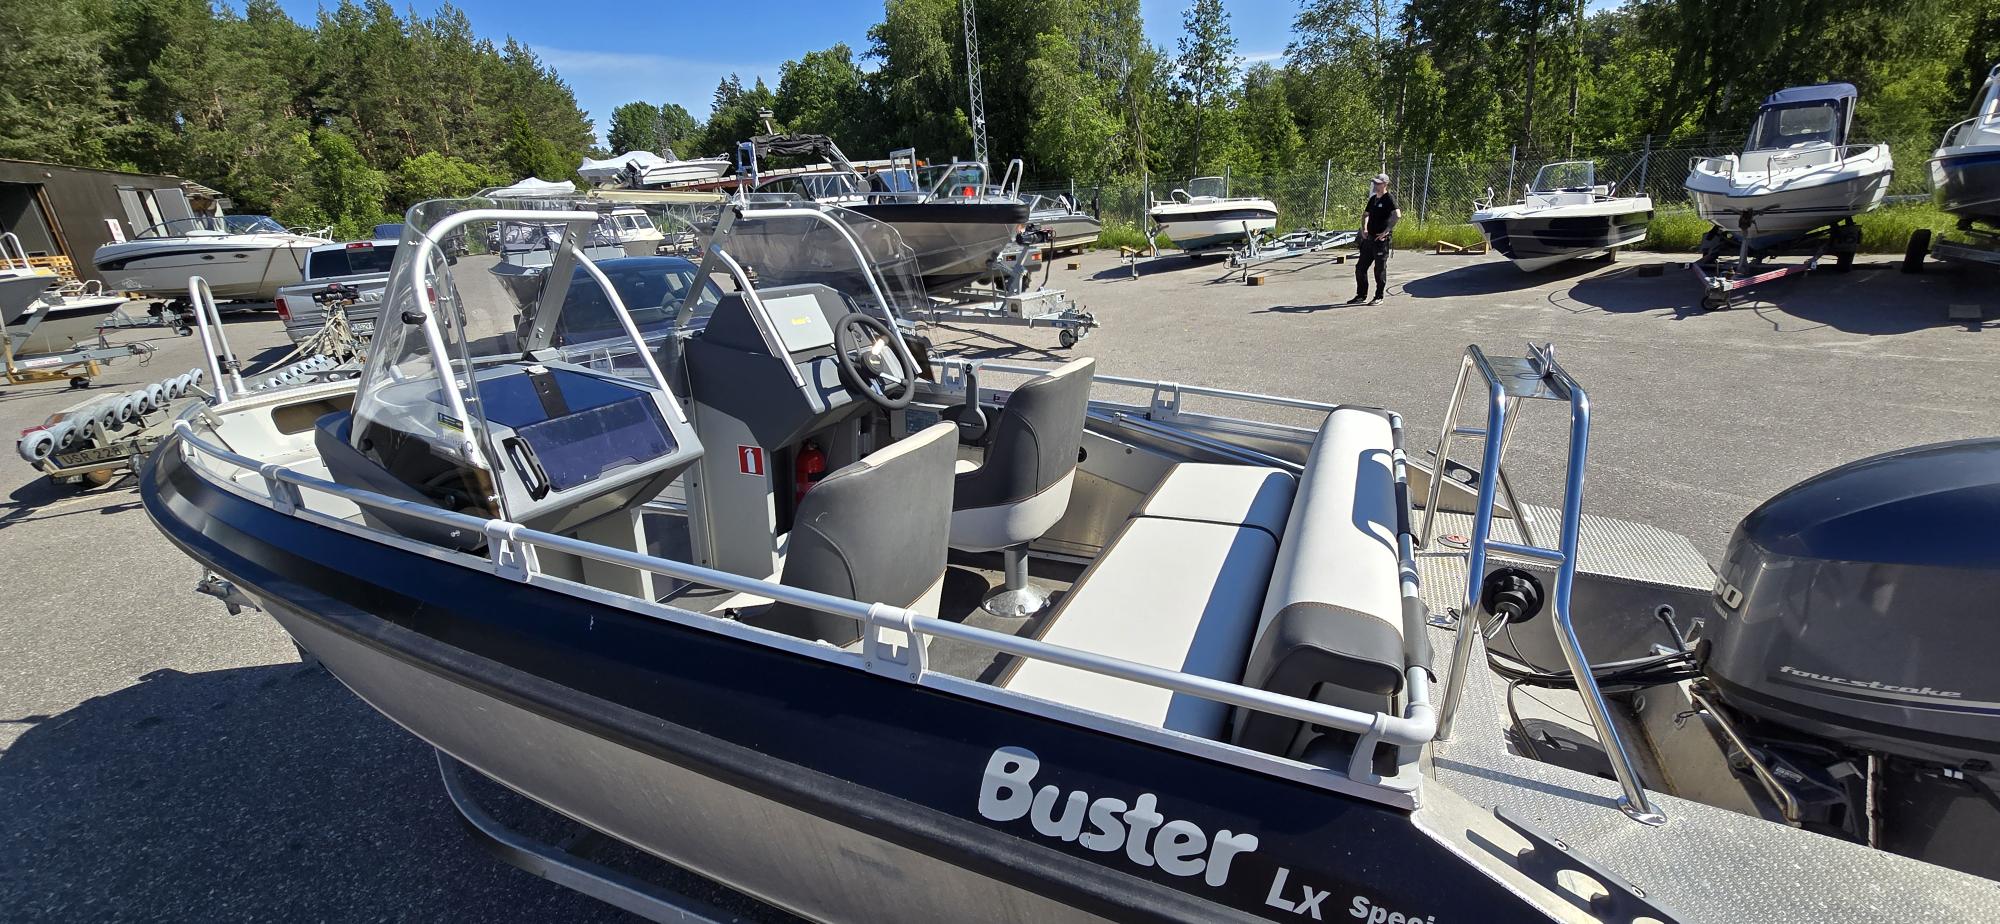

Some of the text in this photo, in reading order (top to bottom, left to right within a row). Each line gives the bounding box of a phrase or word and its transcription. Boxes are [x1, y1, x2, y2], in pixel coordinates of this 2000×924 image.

[61, 452, 91, 465] USR
[1779, 665, 1962, 698] fourstroke
[977, 745, 1259, 888] Buster
